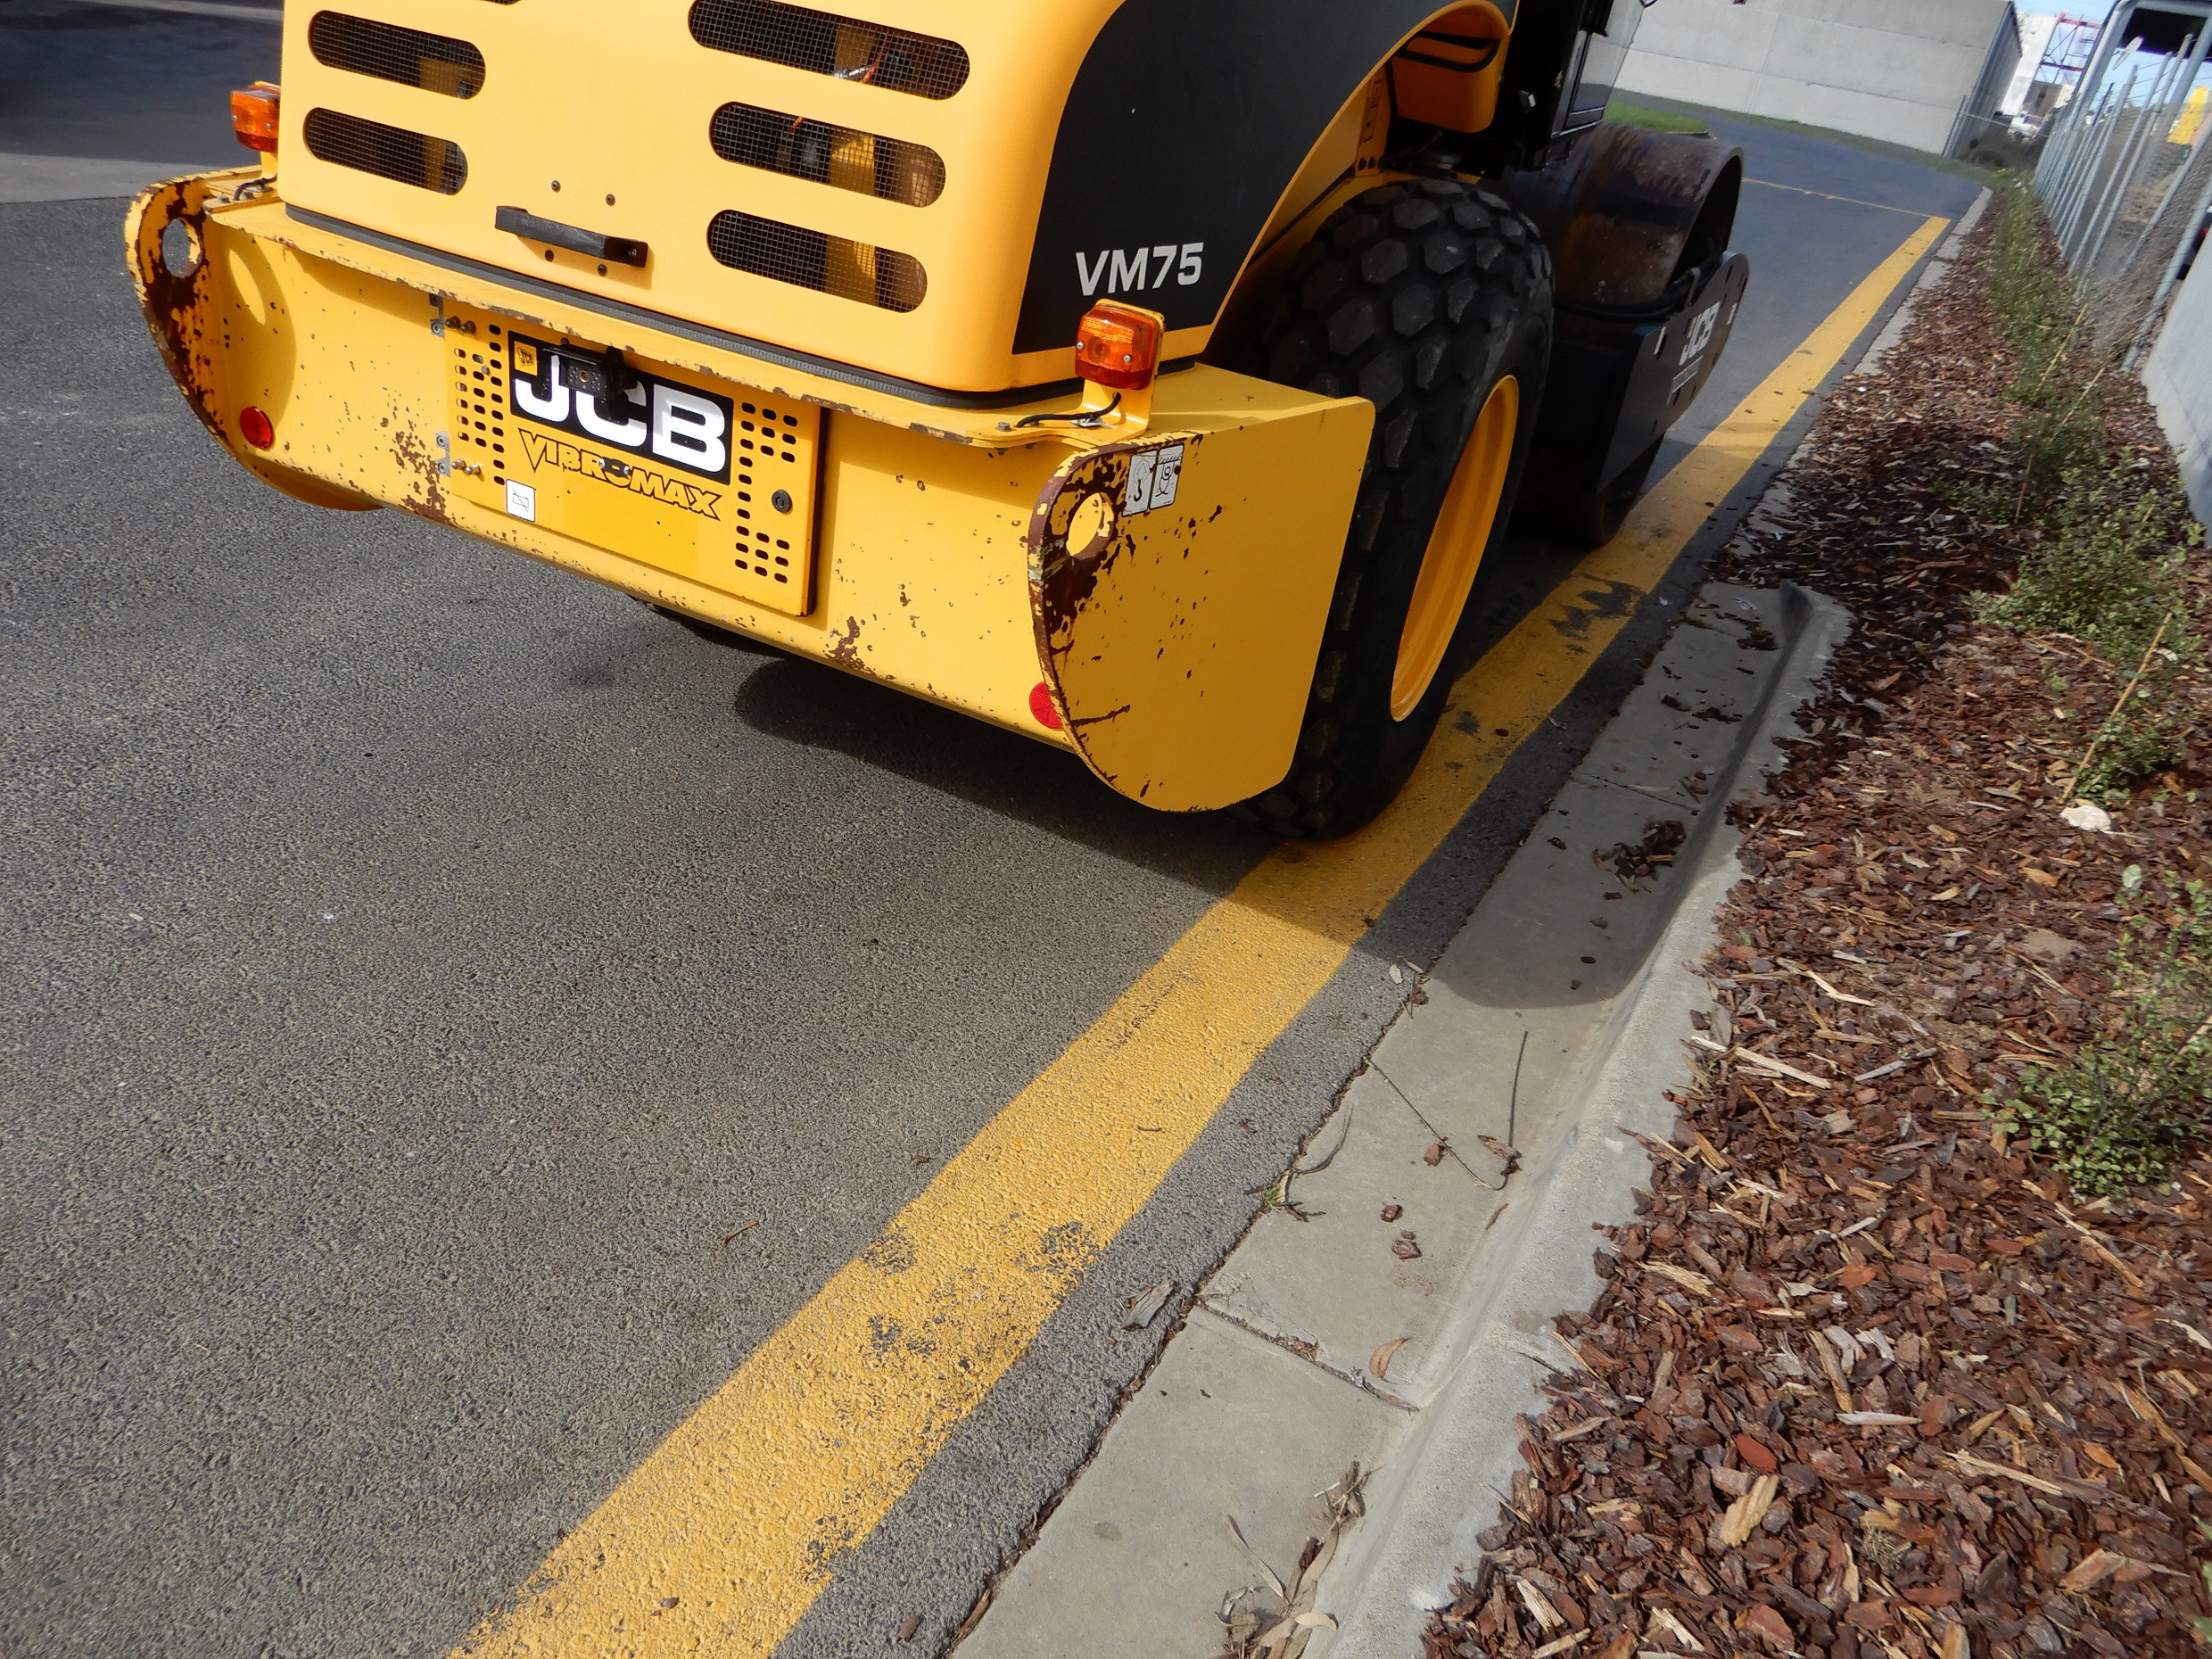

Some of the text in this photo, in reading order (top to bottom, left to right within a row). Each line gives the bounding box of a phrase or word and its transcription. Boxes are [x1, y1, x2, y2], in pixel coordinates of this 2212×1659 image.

[1075, 242, 1204, 296] VM75
[519, 349, 534, 365] JCB
[1679, 301, 1720, 367] JCB
[515, 354, 726, 474] JCB
[517, 427, 722, 521] VIBROMAX
